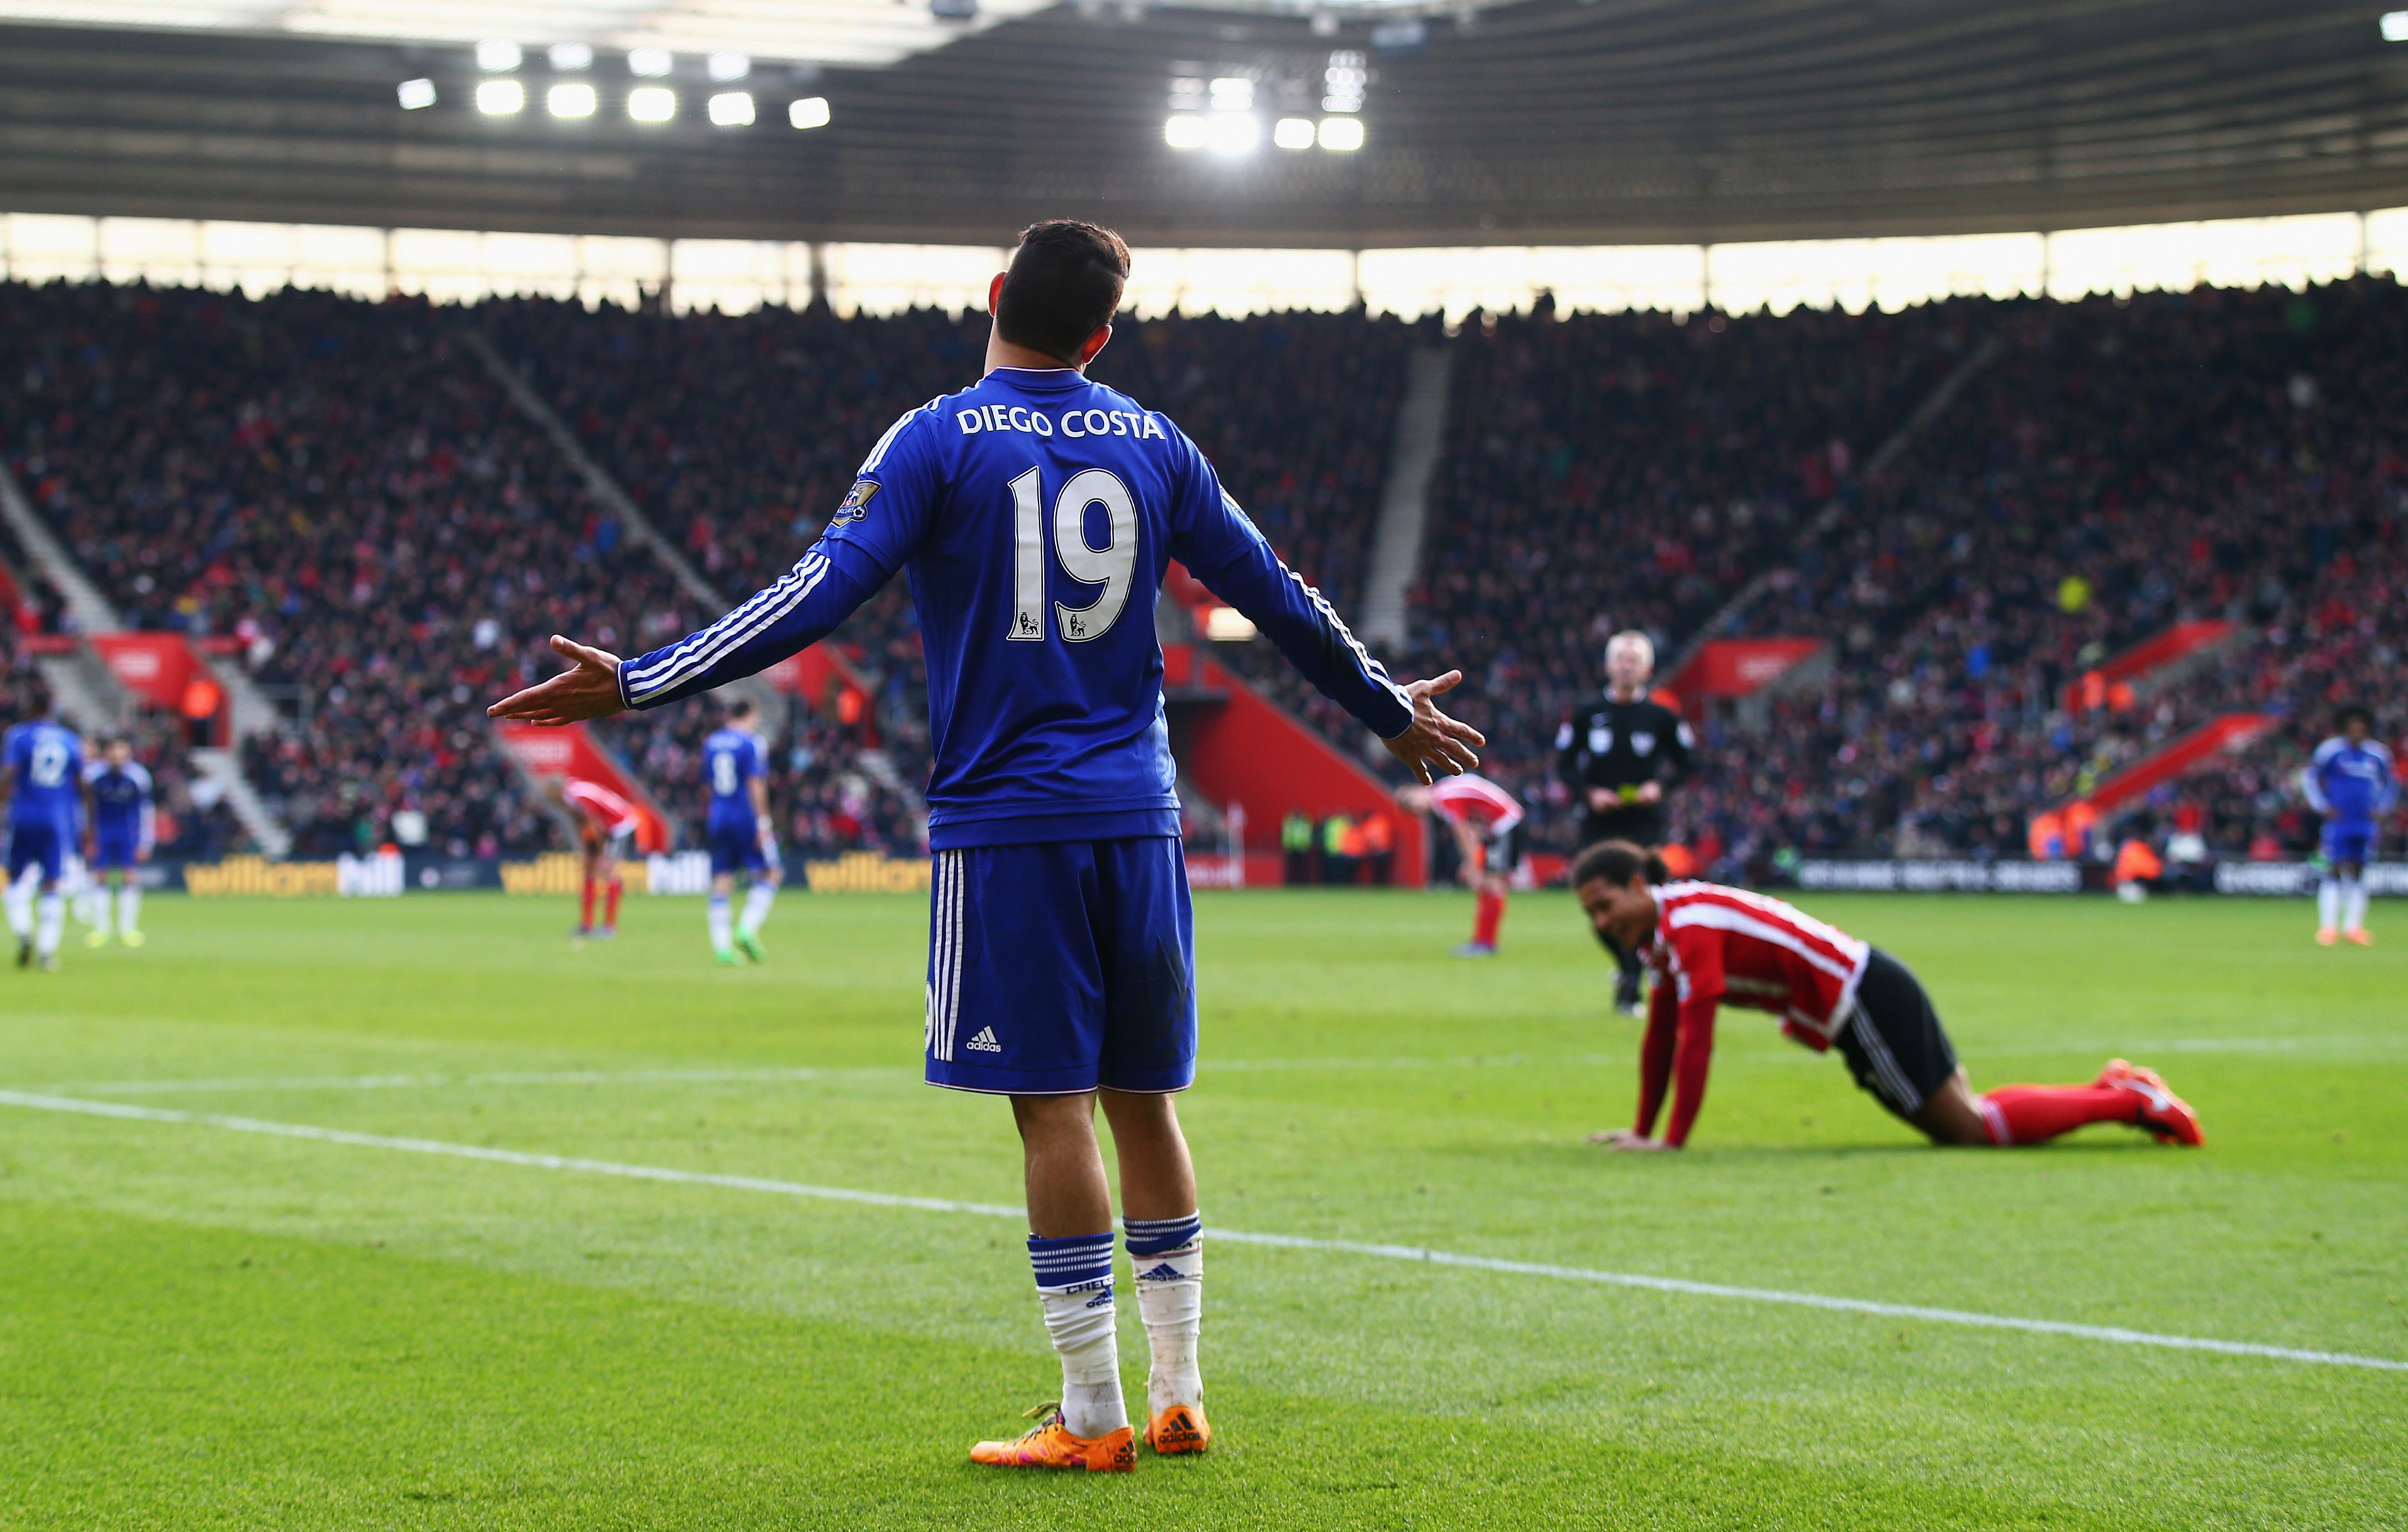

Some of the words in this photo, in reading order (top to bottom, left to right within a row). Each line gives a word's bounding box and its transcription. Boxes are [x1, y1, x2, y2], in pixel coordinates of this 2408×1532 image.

[956, 404, 1054, 438] DIEGO
[1060, 409, 1166, 440] COSTA
[1005, 465, 1139, 643] 19
[966, 1041, 1002, 1053] adidas
